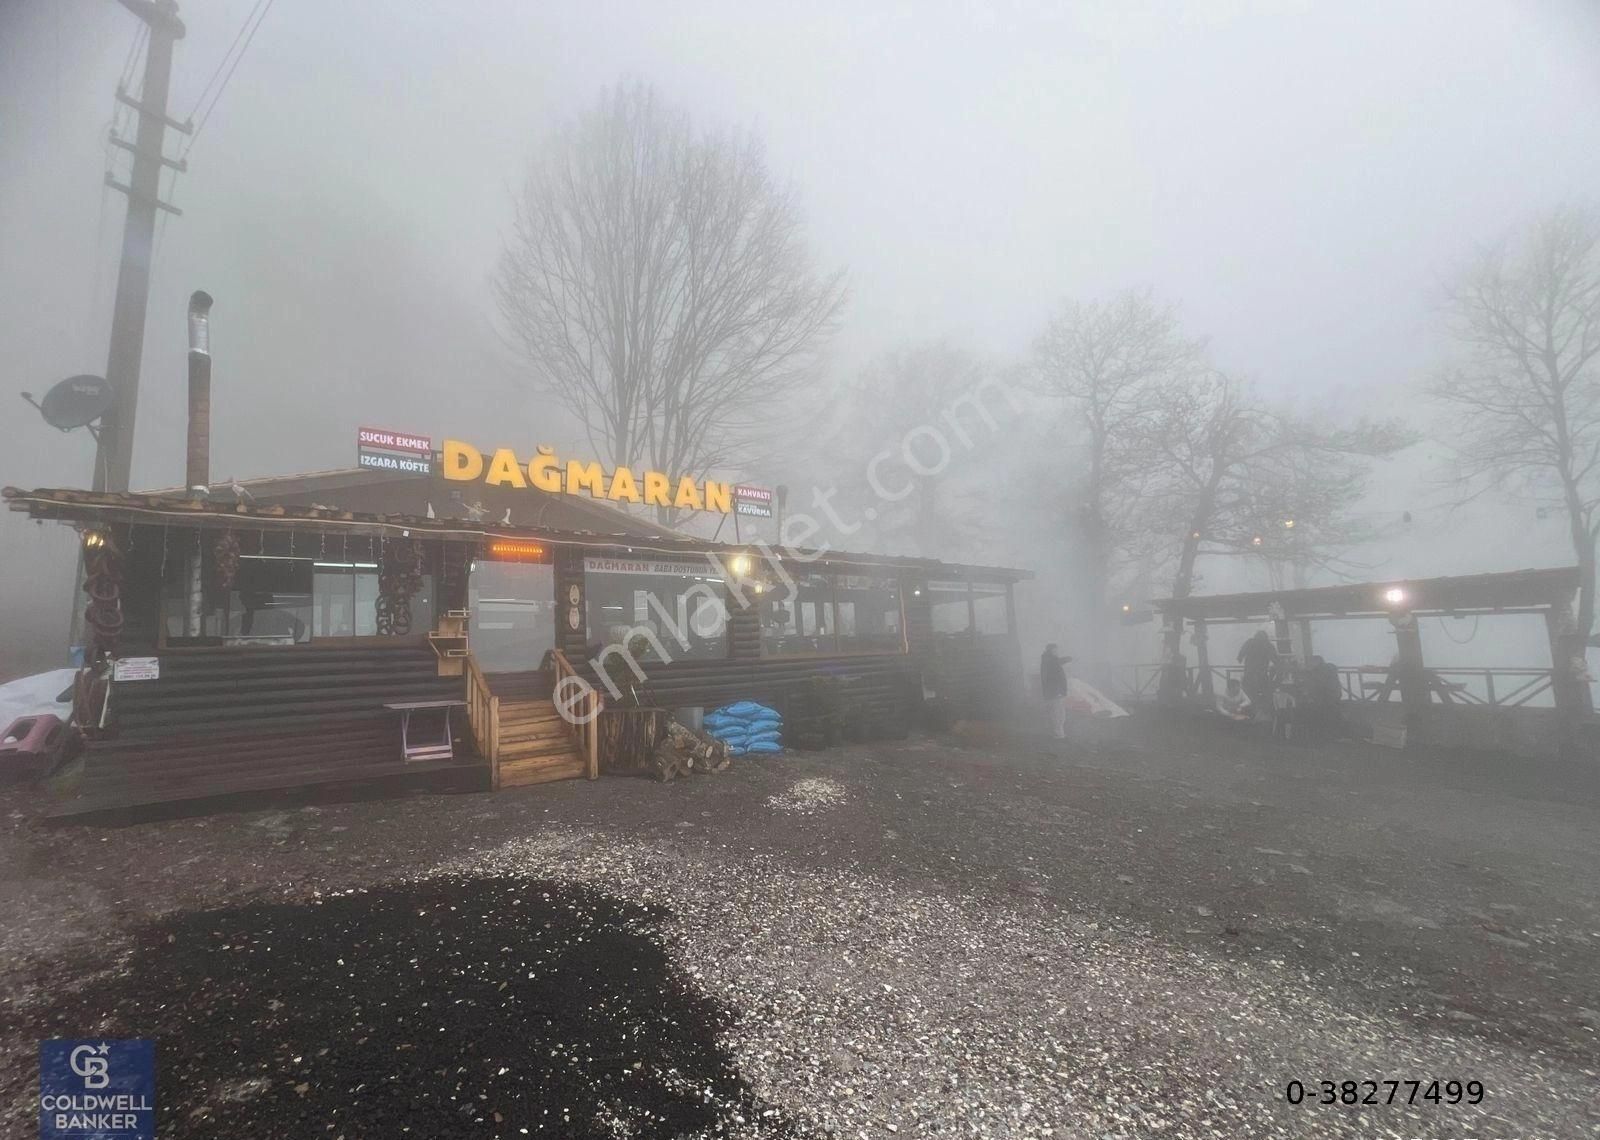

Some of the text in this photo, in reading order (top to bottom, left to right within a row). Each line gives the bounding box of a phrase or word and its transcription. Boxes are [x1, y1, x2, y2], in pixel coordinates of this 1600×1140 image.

[360, 431, 429, 450] SUCUK EKMEK
[360, 455, 430, 473] IZGARA KÖFTE
[442, 440, 733, 513] DAĞMARAN
[737, 488, 770, 500] KAHVALTI
[737, 506, 771, 517] KAVURMA
